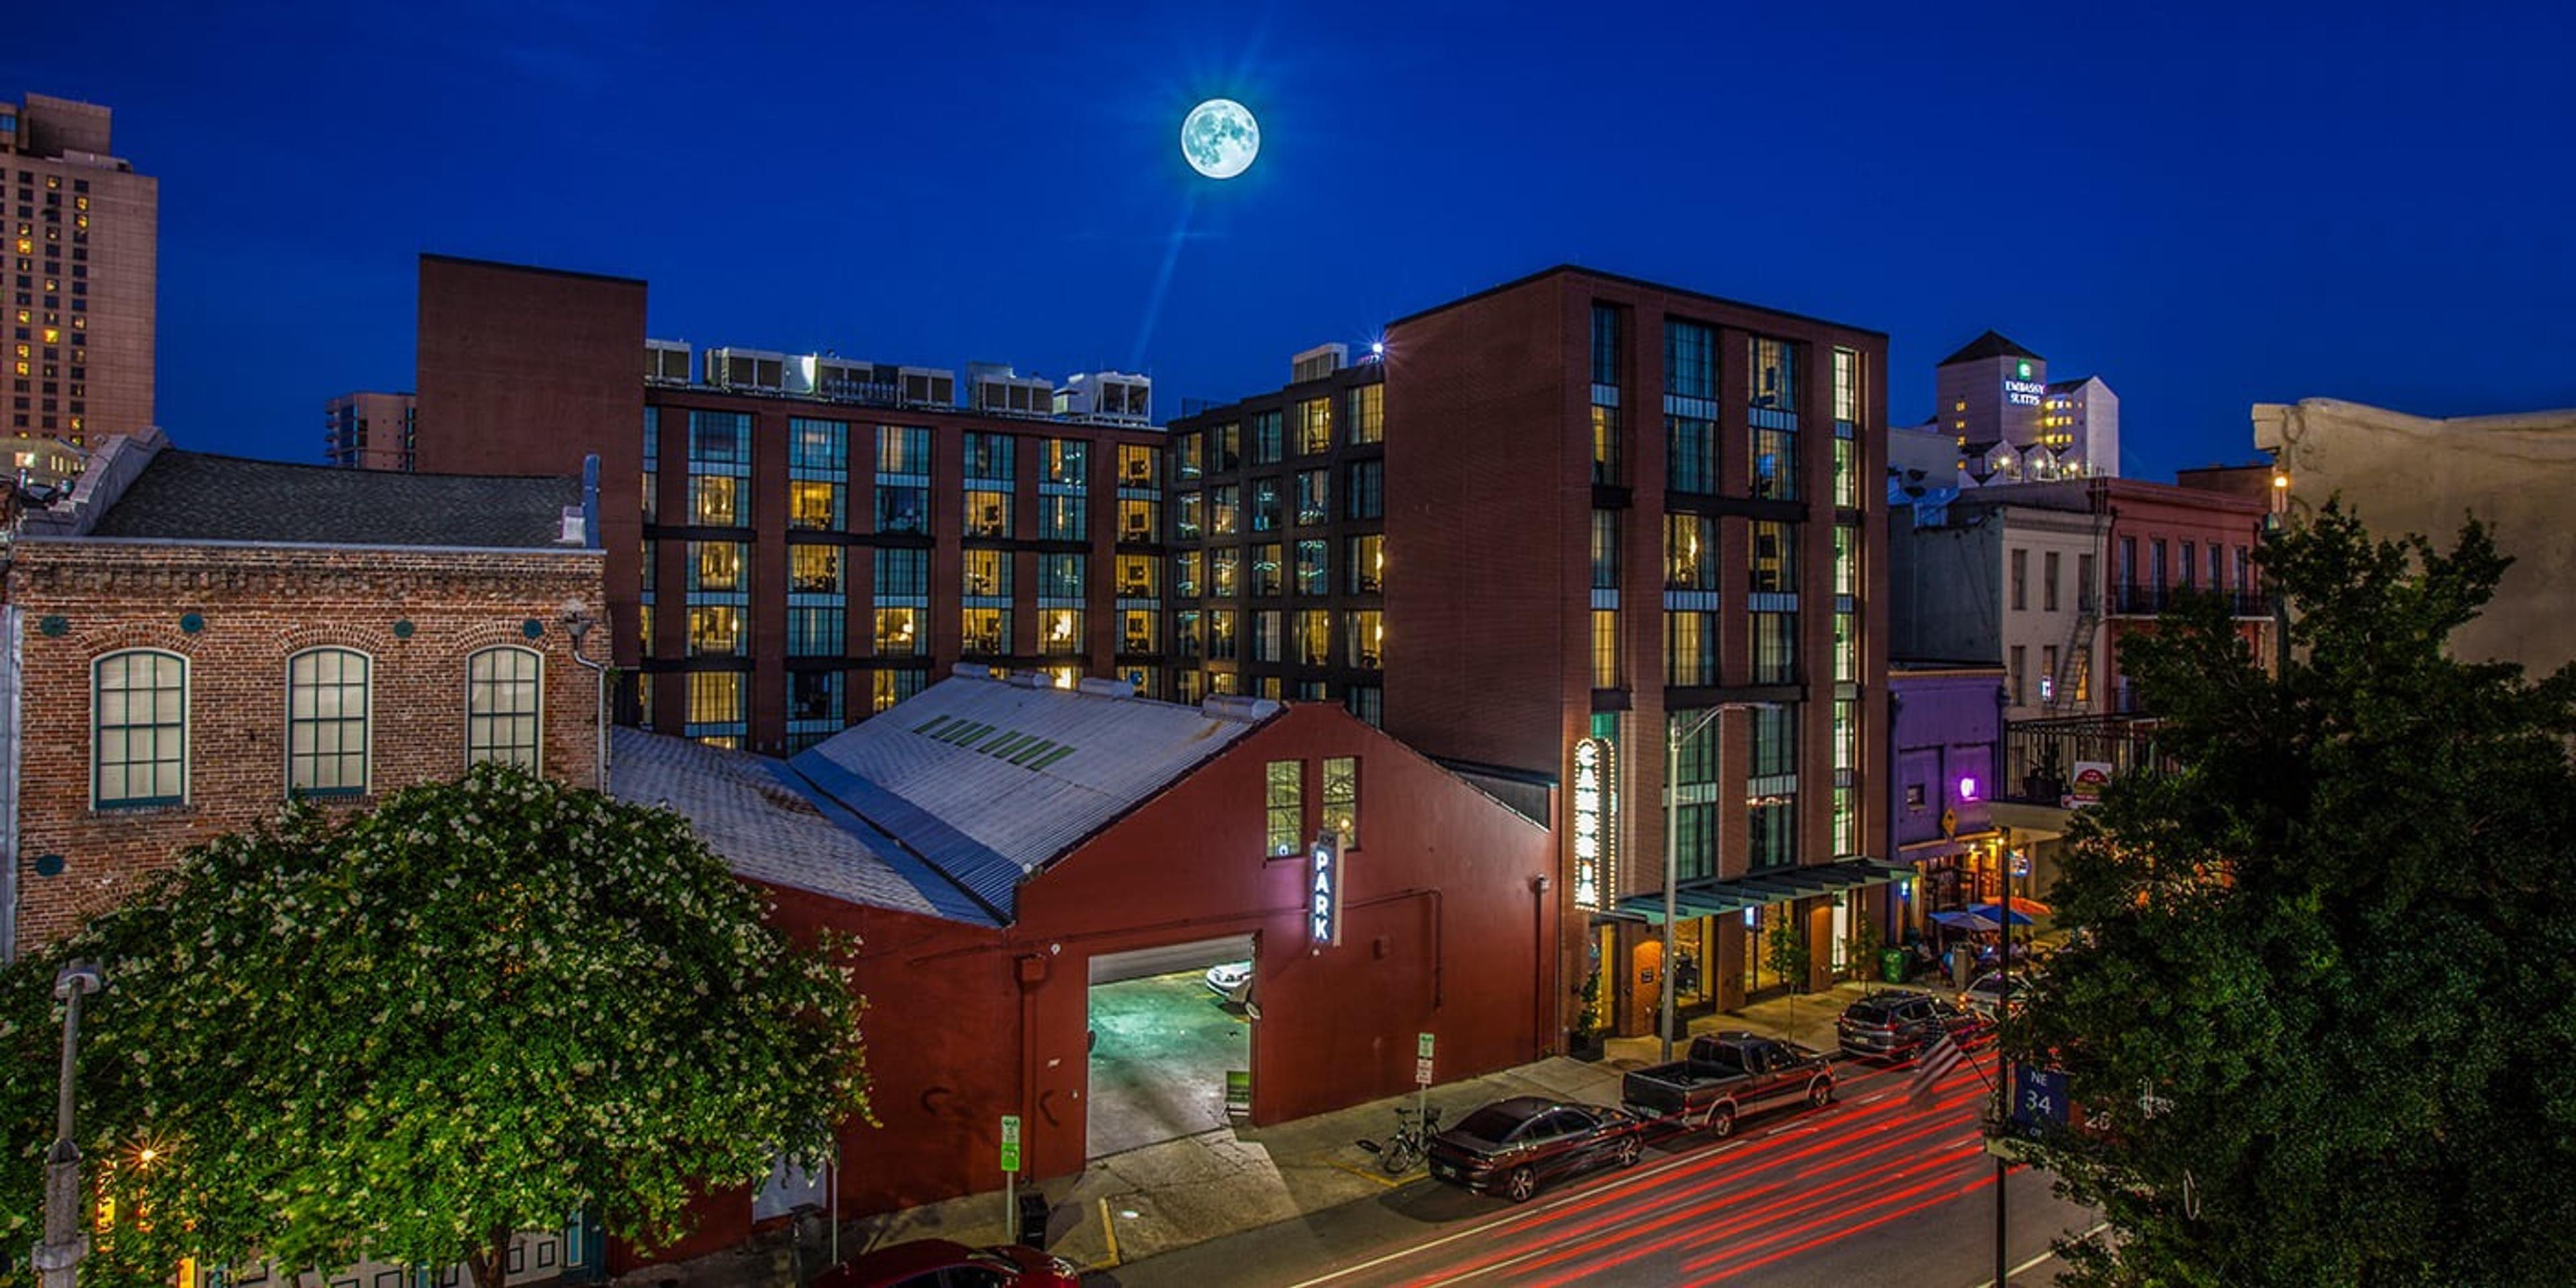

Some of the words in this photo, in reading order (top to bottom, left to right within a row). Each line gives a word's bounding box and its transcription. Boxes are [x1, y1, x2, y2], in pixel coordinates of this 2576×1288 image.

[2005, 380, 2045, 394] EMBASSY
[2010, 393, 2040, 405] SUITES
[1578, 745, 1597, 903] CAMBRIA
[1315, 850, 1329, 940] PARK
[2031, 1071, 2047, 1086] NE
[2025, 1089, 2051, 1114] 34
